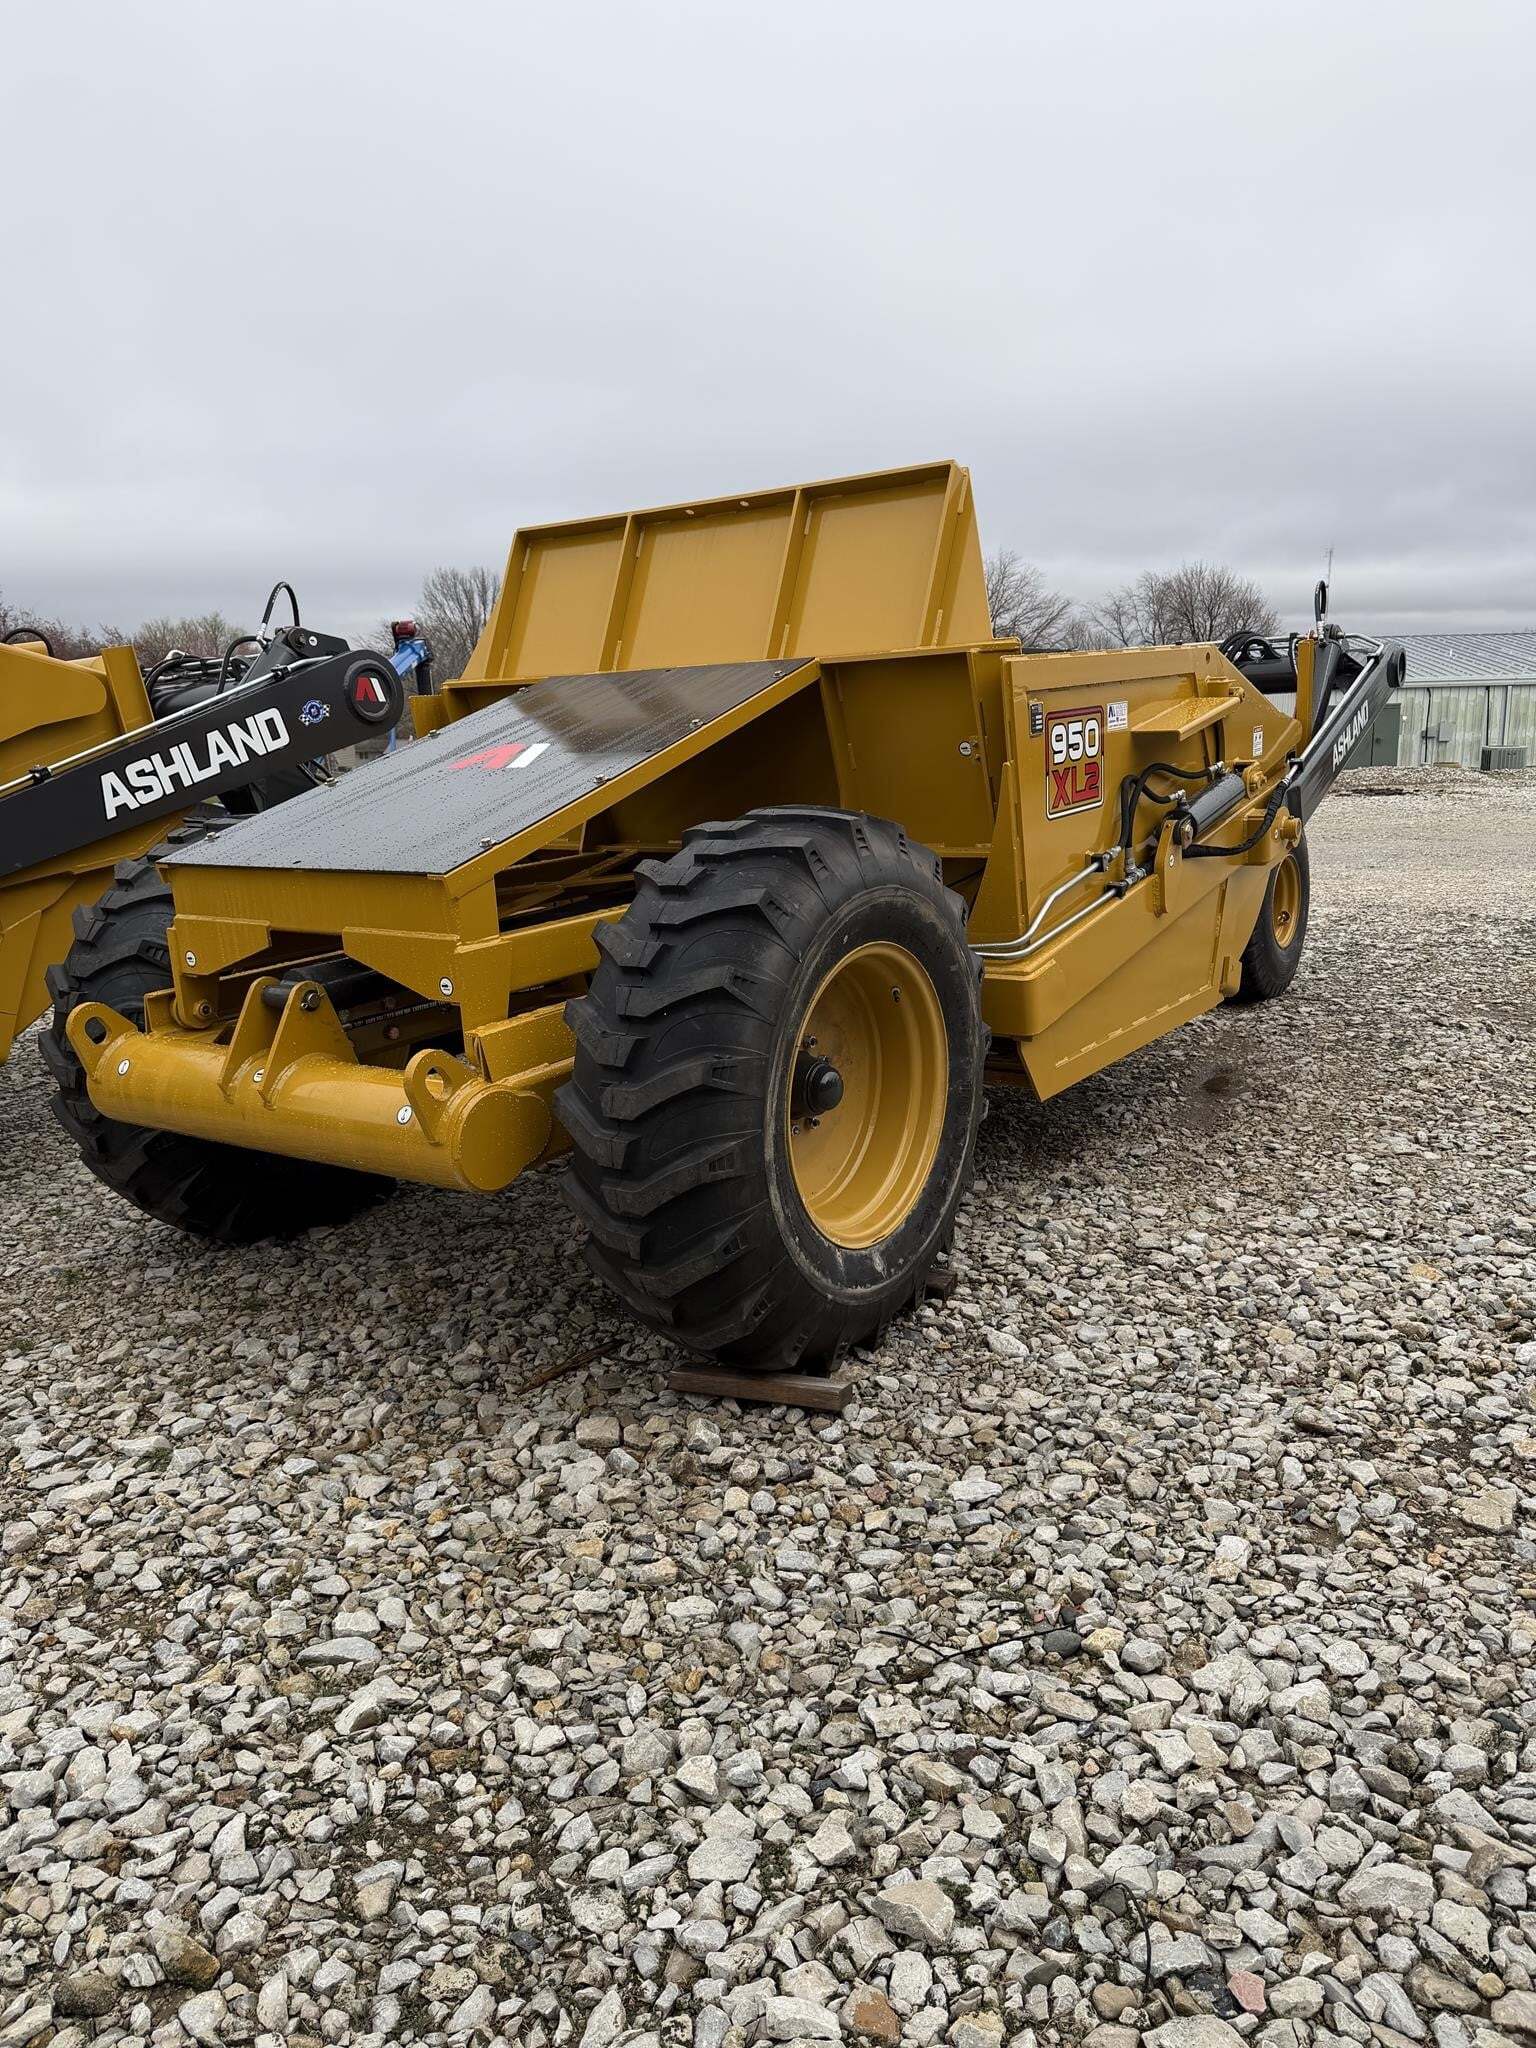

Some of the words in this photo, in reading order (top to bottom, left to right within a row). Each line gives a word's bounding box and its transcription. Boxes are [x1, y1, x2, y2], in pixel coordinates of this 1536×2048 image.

[100, 707, 290, 820] ASHLAND
[1051, 718, 1100, 766] 950
[1332, 699, 1369, 773] ASHLAND
[1051, 762, 1100, 810] XL2
